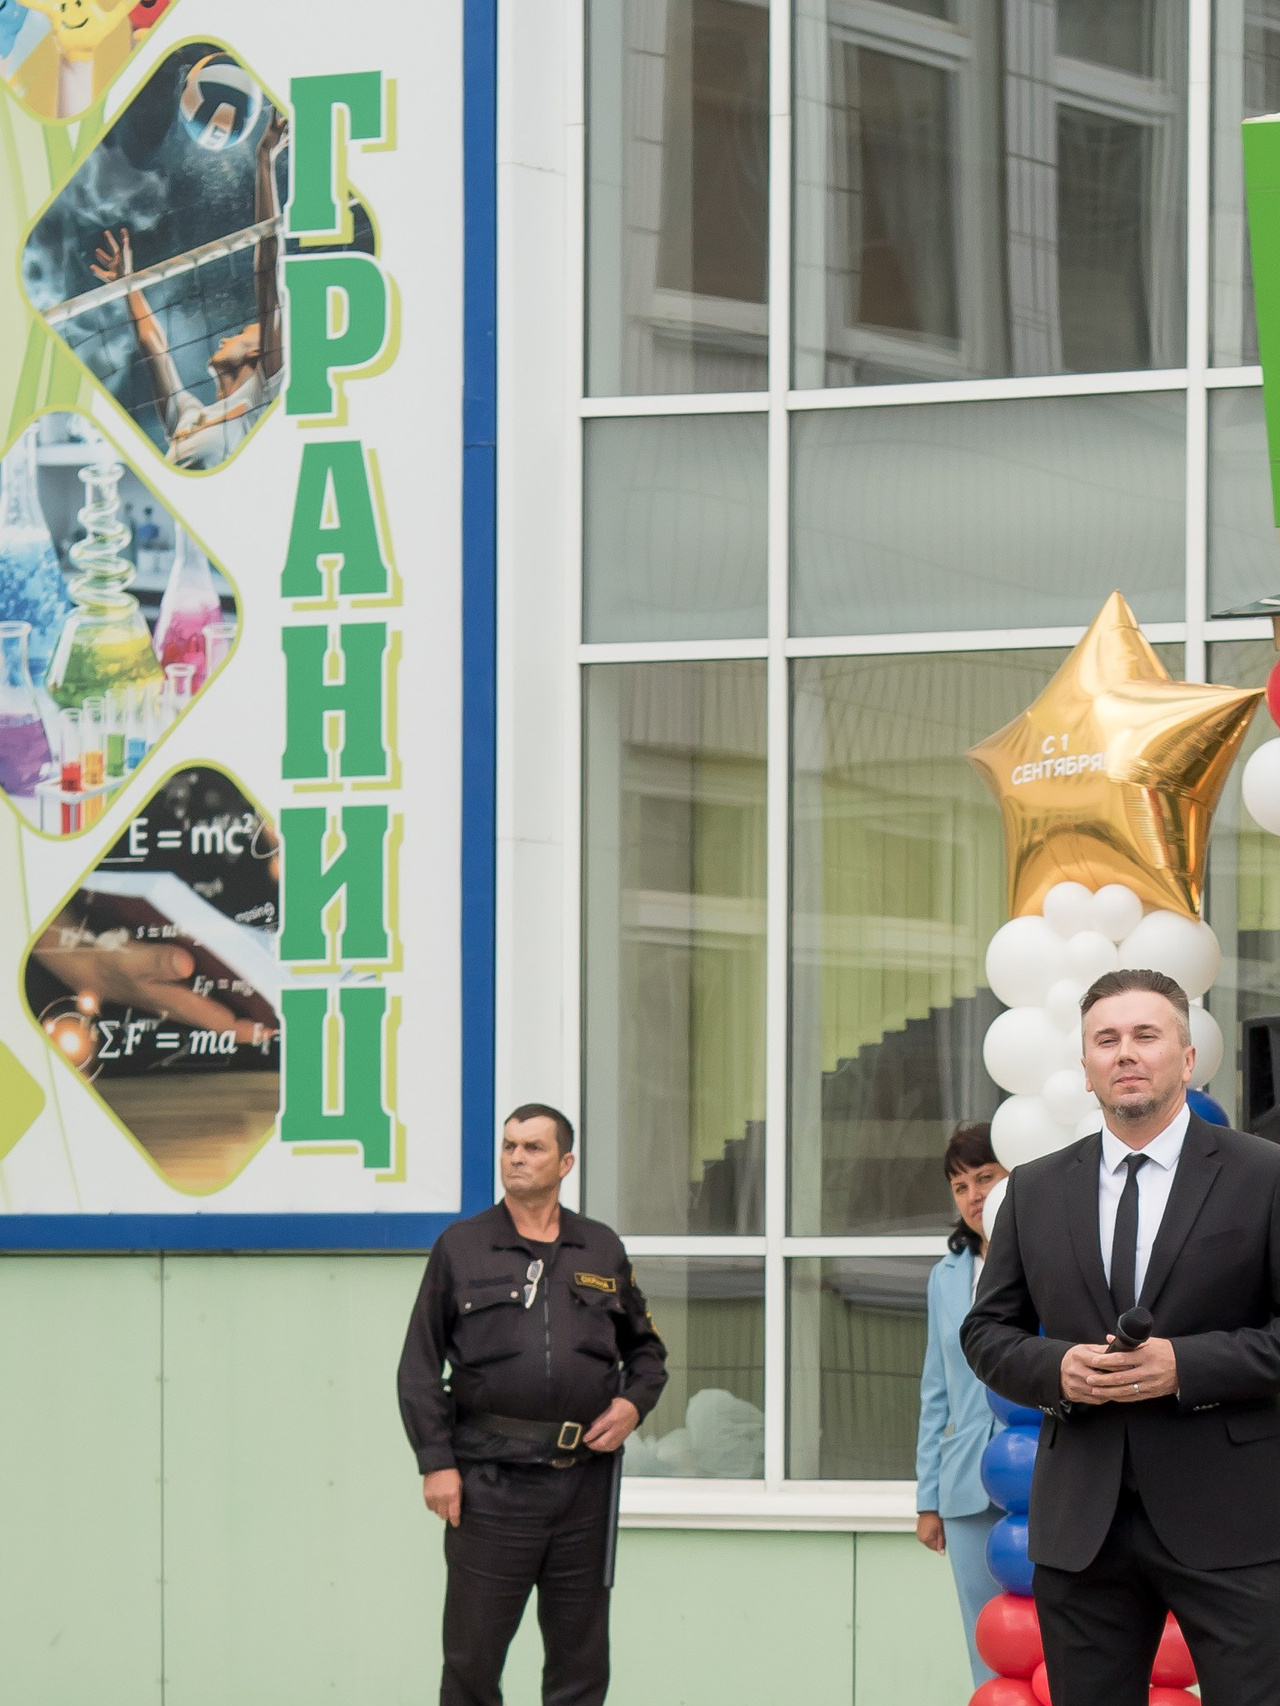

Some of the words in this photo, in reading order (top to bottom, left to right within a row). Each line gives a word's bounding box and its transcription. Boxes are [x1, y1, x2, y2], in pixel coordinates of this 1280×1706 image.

[279, 70, 404, 1183] ГРАНИЦ
[1041, 735, 1056, 755] С
[1061, 733, 1069, 752] 1
[129, 818, 149, 856] E
[189, 1029, 238, 1055] ma
